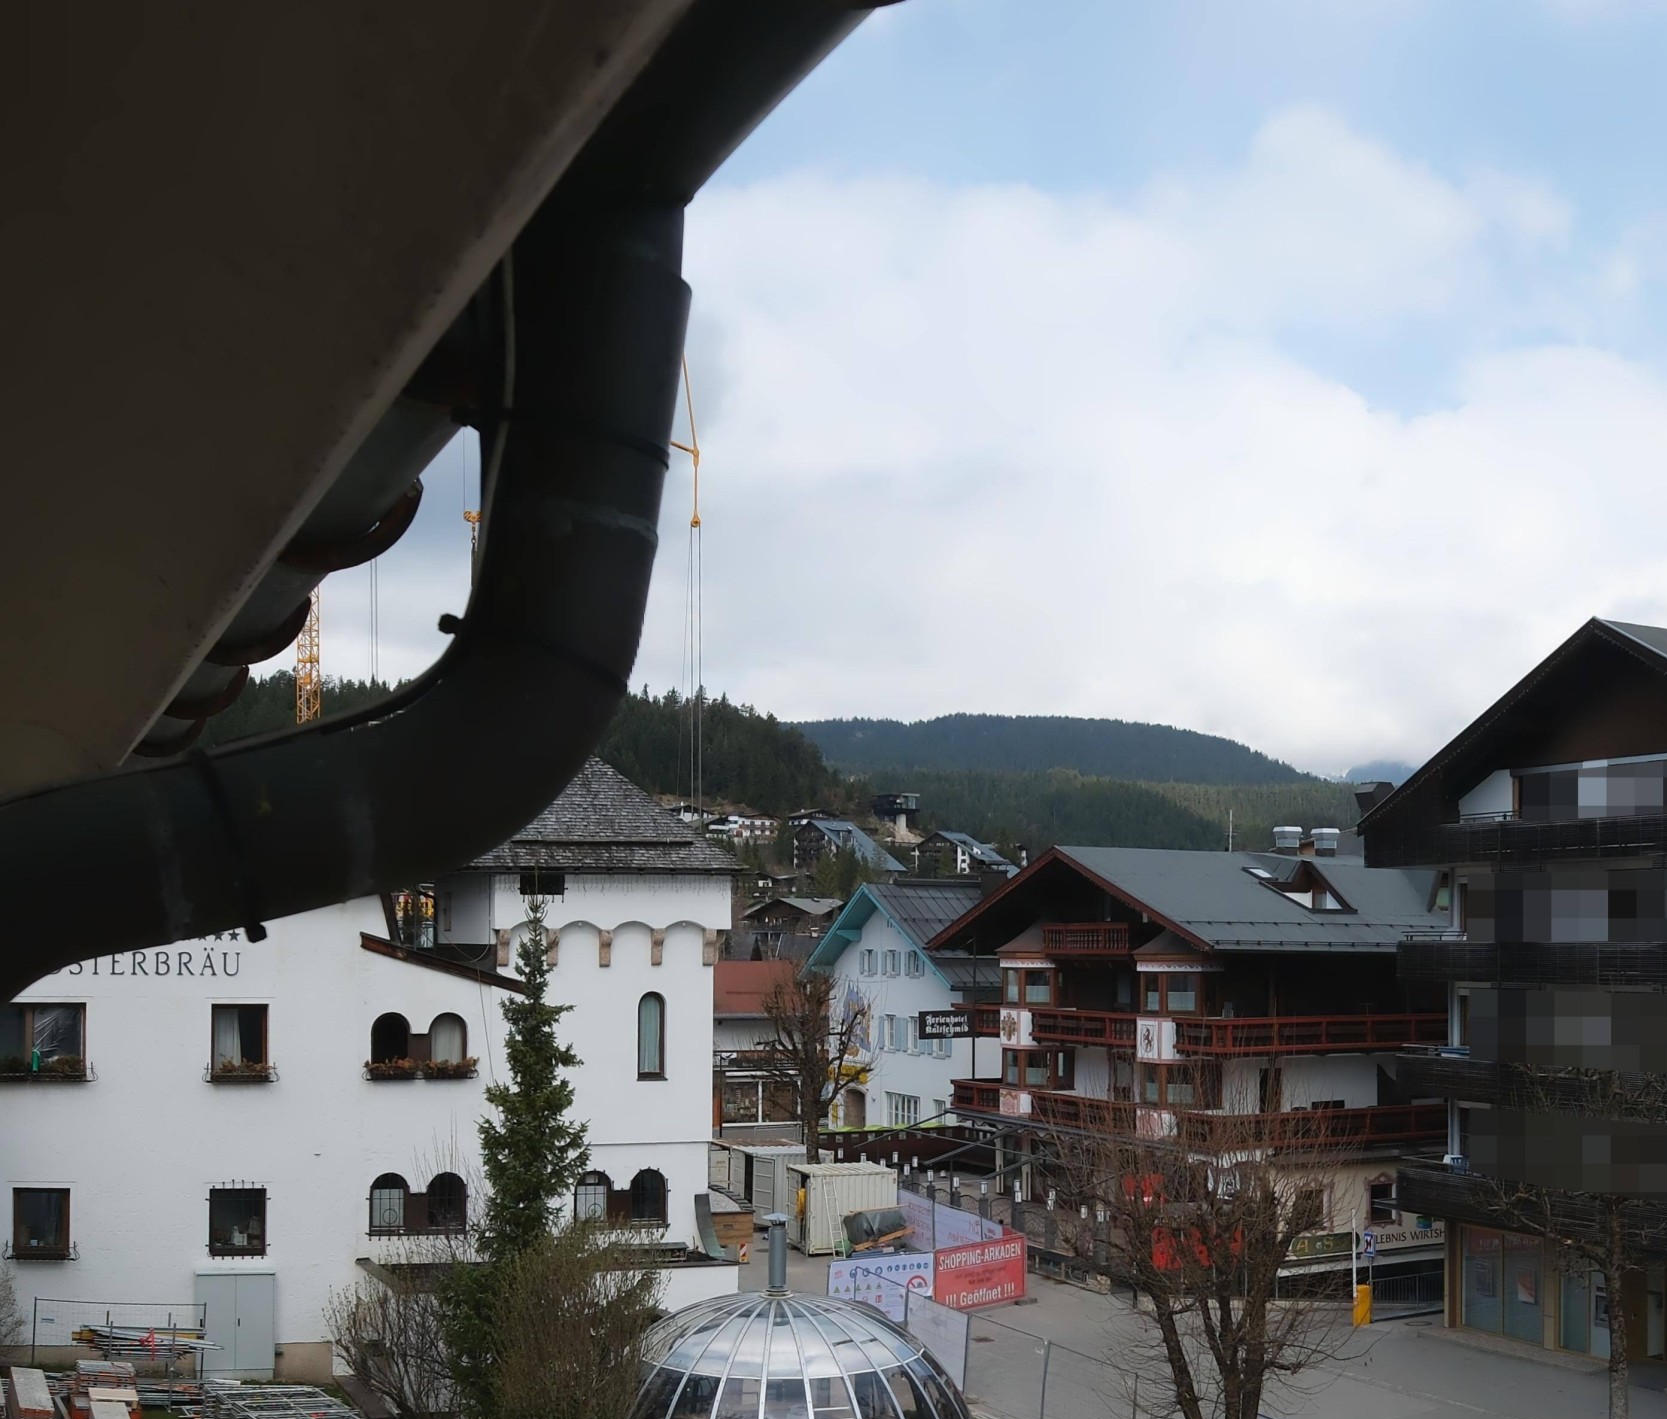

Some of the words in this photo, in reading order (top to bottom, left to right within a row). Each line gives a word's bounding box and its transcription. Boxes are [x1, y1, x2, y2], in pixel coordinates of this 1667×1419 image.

[49, 947, 241, 977] STERBRÄU
[938, 1242, 1021, 1271] SHOPPING-ARKADEN
[960, 1288, 1001, 1307] Geöffnet
